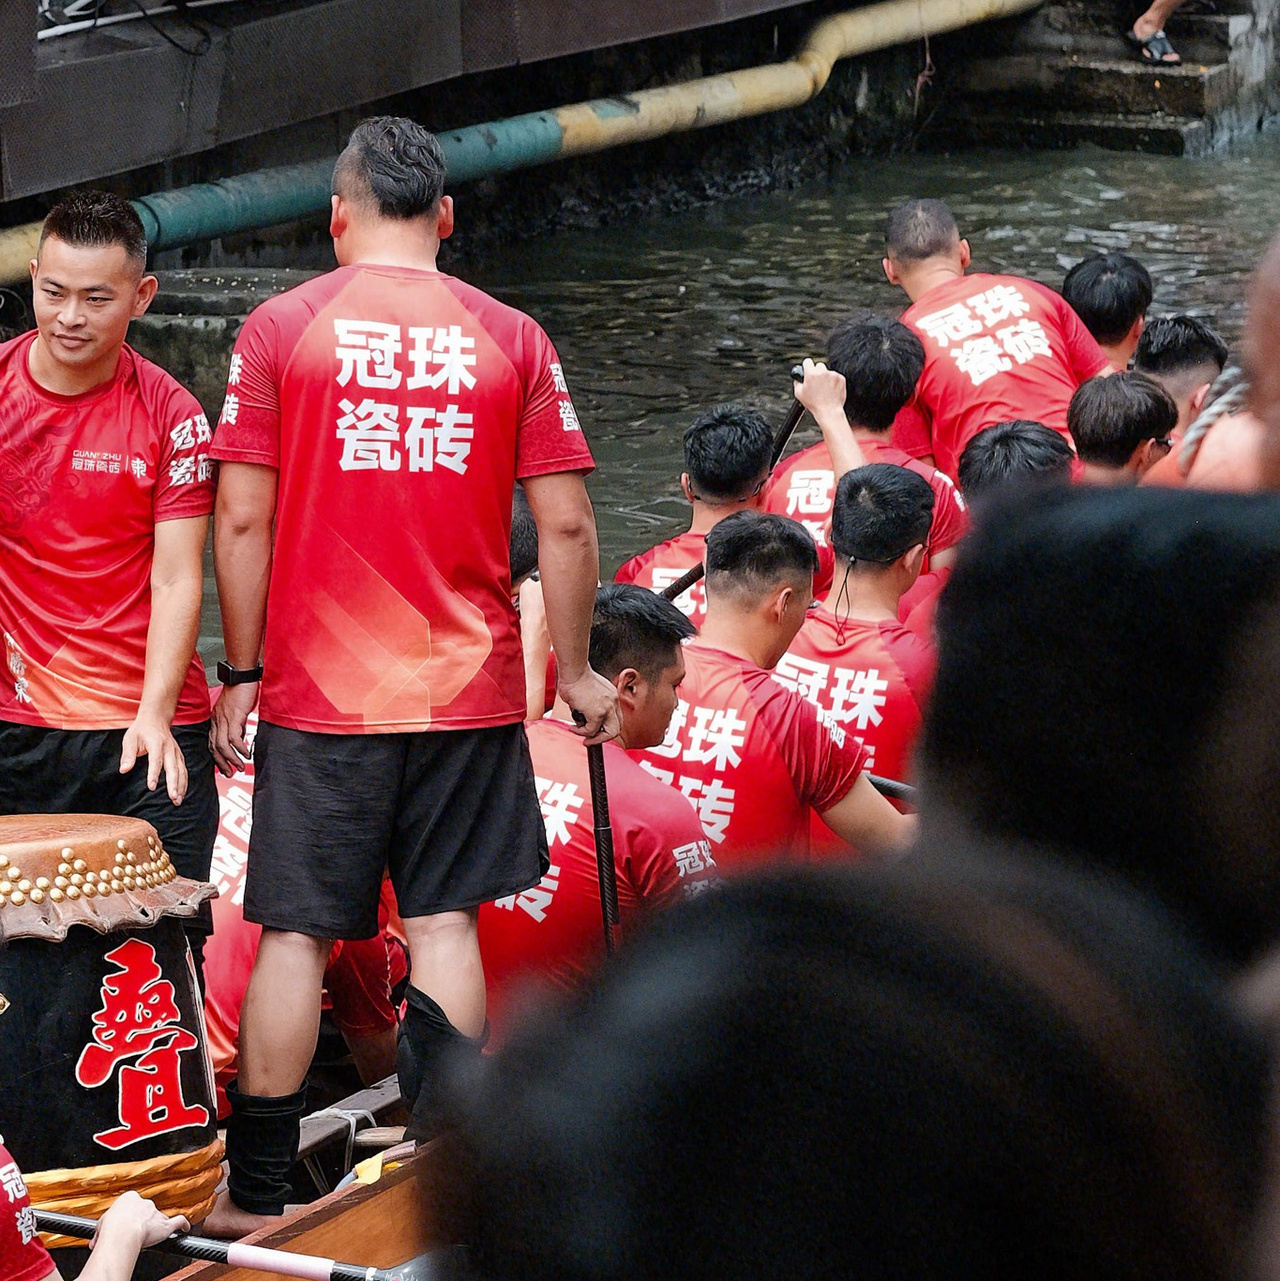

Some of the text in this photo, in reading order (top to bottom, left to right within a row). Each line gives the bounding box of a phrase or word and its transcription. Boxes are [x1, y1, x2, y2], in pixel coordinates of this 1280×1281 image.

[915, 285, 1030, 347] 冠珠
[950, 319, 1052, 386] 瓷砖
[333, 319, 477, 396] 冠珠
[336, 398, 475, 475] 瓷砖
[638, 760, 735, 844] 砖
